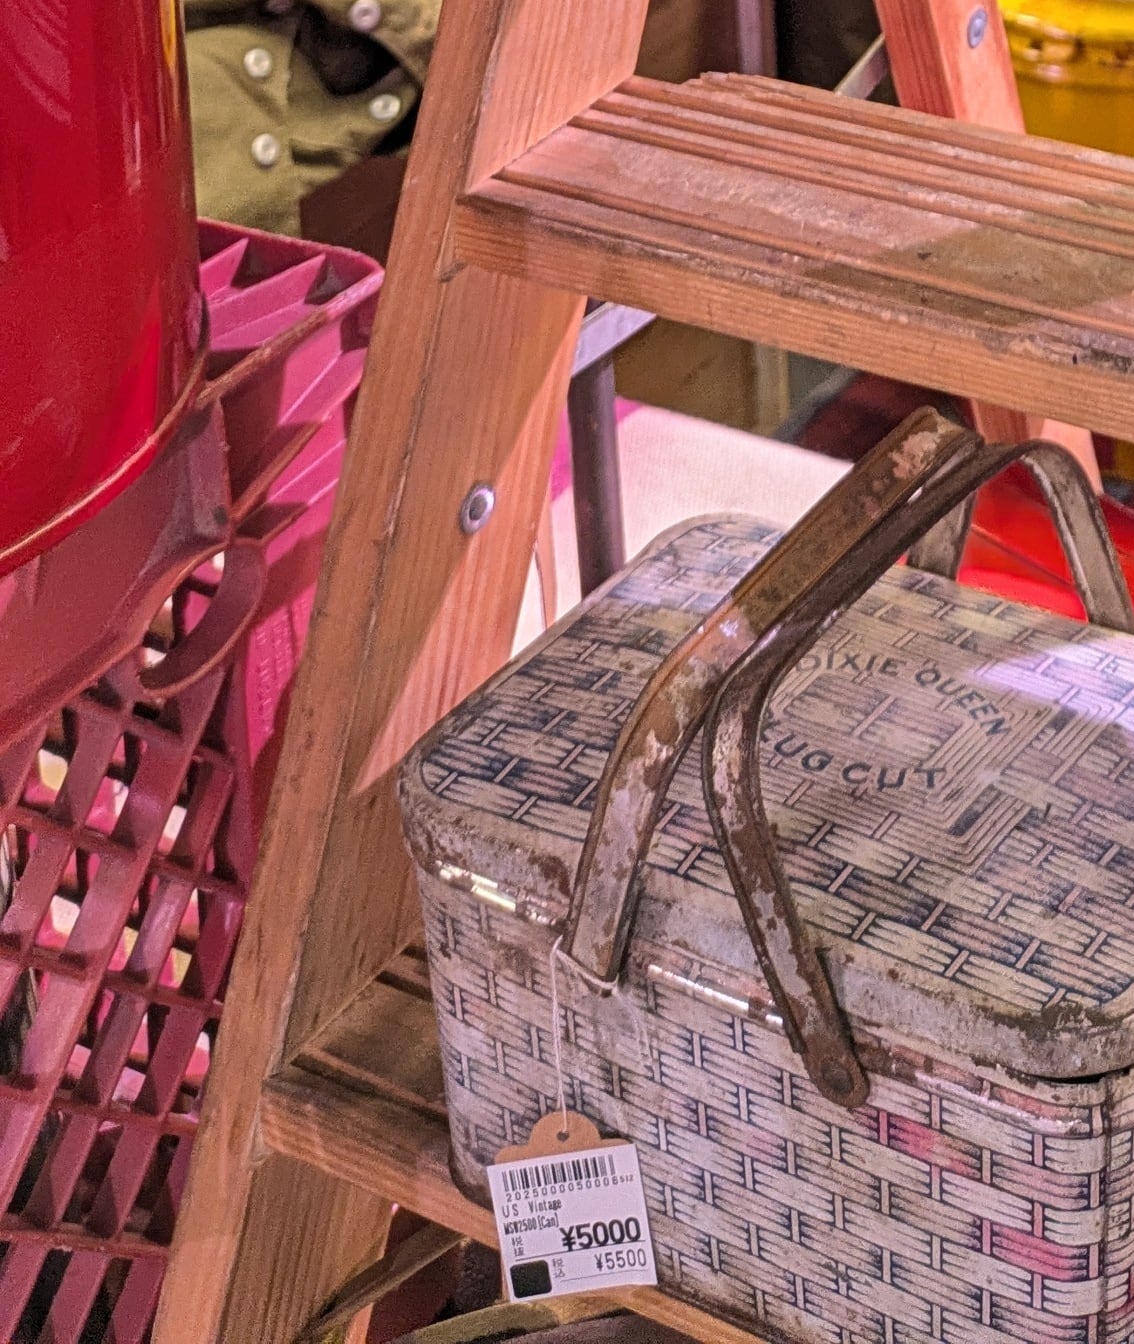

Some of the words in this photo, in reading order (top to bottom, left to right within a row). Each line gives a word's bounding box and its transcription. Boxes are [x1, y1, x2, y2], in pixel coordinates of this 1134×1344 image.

[796, 647, 903, 678] DIXIE
[914, 666, 1012, 738] QUEEN
[760, 705, 834, 772] LUG
[842, 761, 946, 793] CUT
[502, 1203, 519, 1218] US
[528, 1199, 562, 1213] Vintage
[560, 1216, 641, 1252] ¥5000
[594, 1248, 647, 1272] ¥5500
